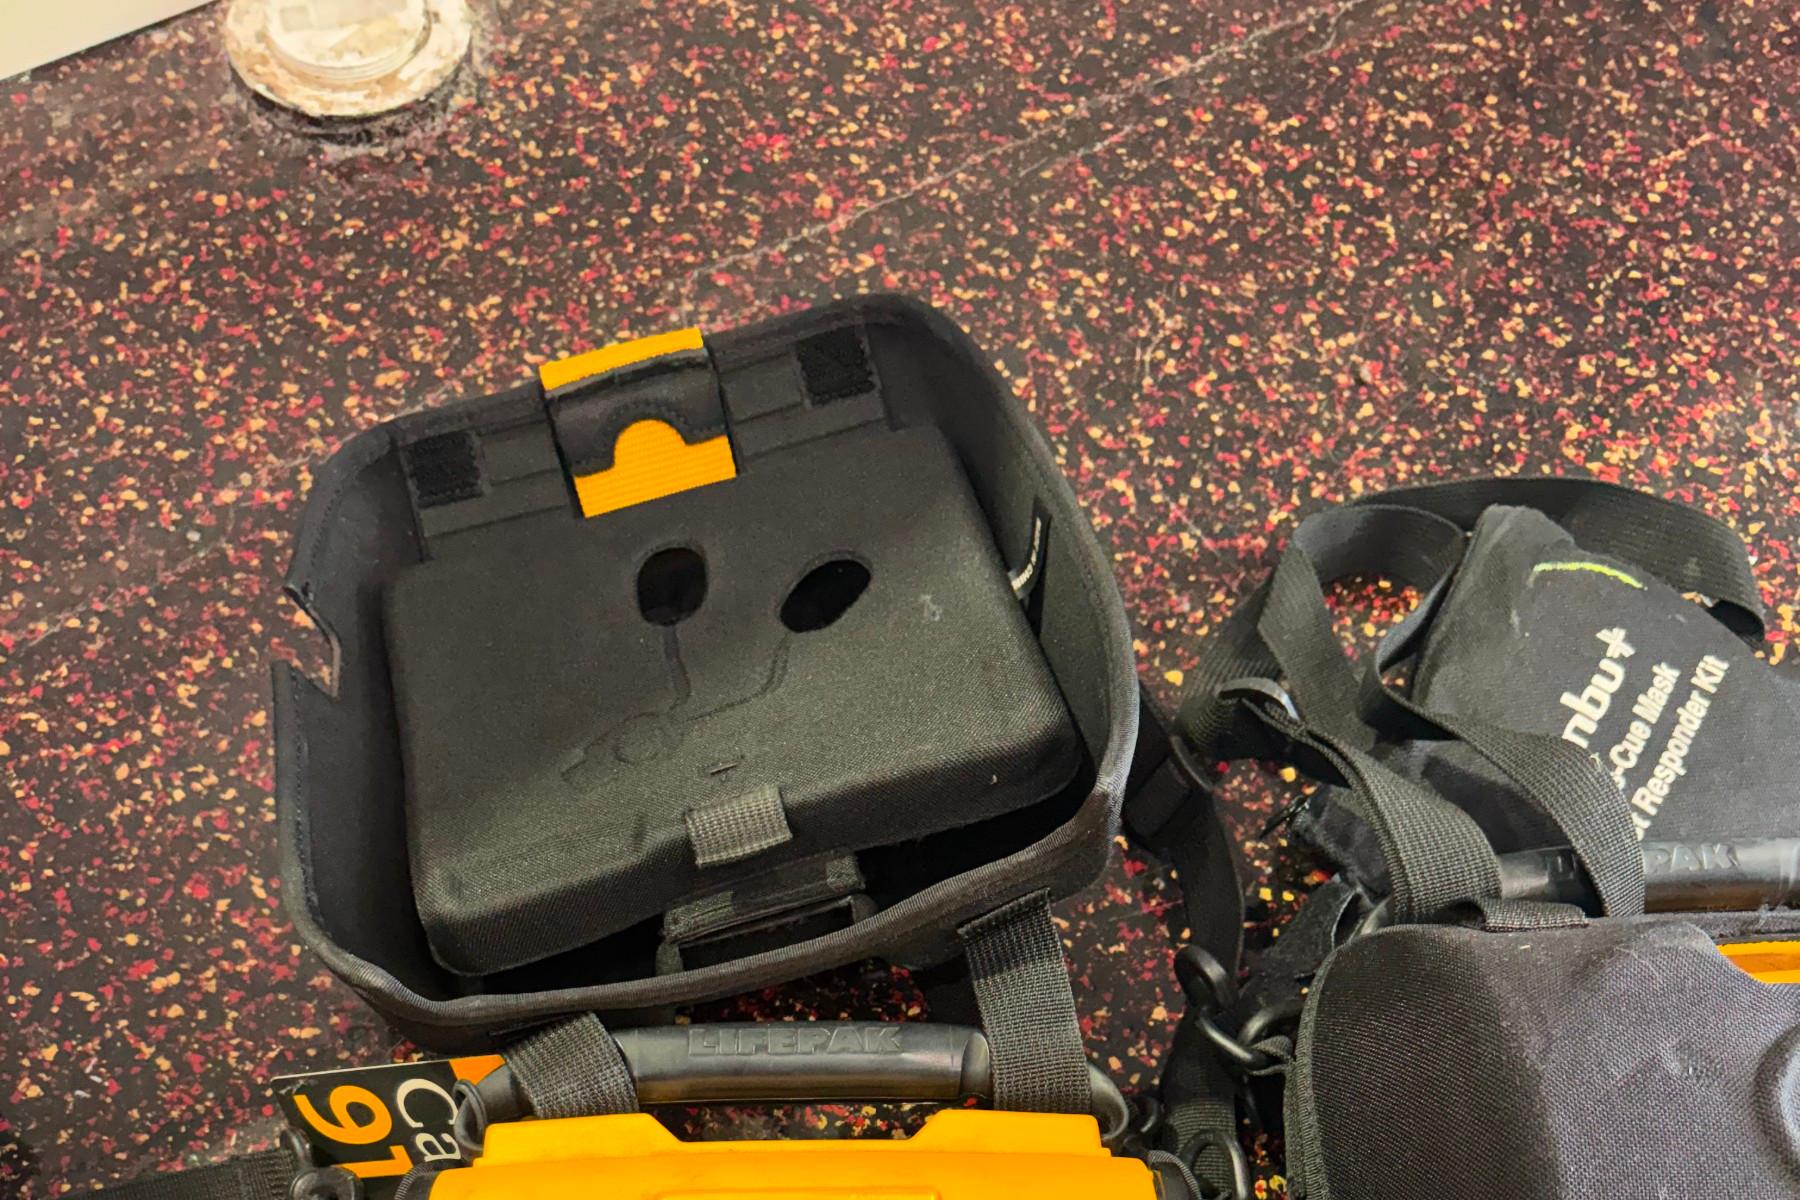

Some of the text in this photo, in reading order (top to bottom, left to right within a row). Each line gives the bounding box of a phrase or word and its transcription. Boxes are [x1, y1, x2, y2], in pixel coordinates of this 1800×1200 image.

[1632, 662, 1681, 724] Mask
[1631, 655, 1730, 817] Responder Kit
[688, 1027, 902, 1057] LIFEPAK
[294, 1085, 414, 1179] 91
[396, 1078, 463, 1163] Ca
